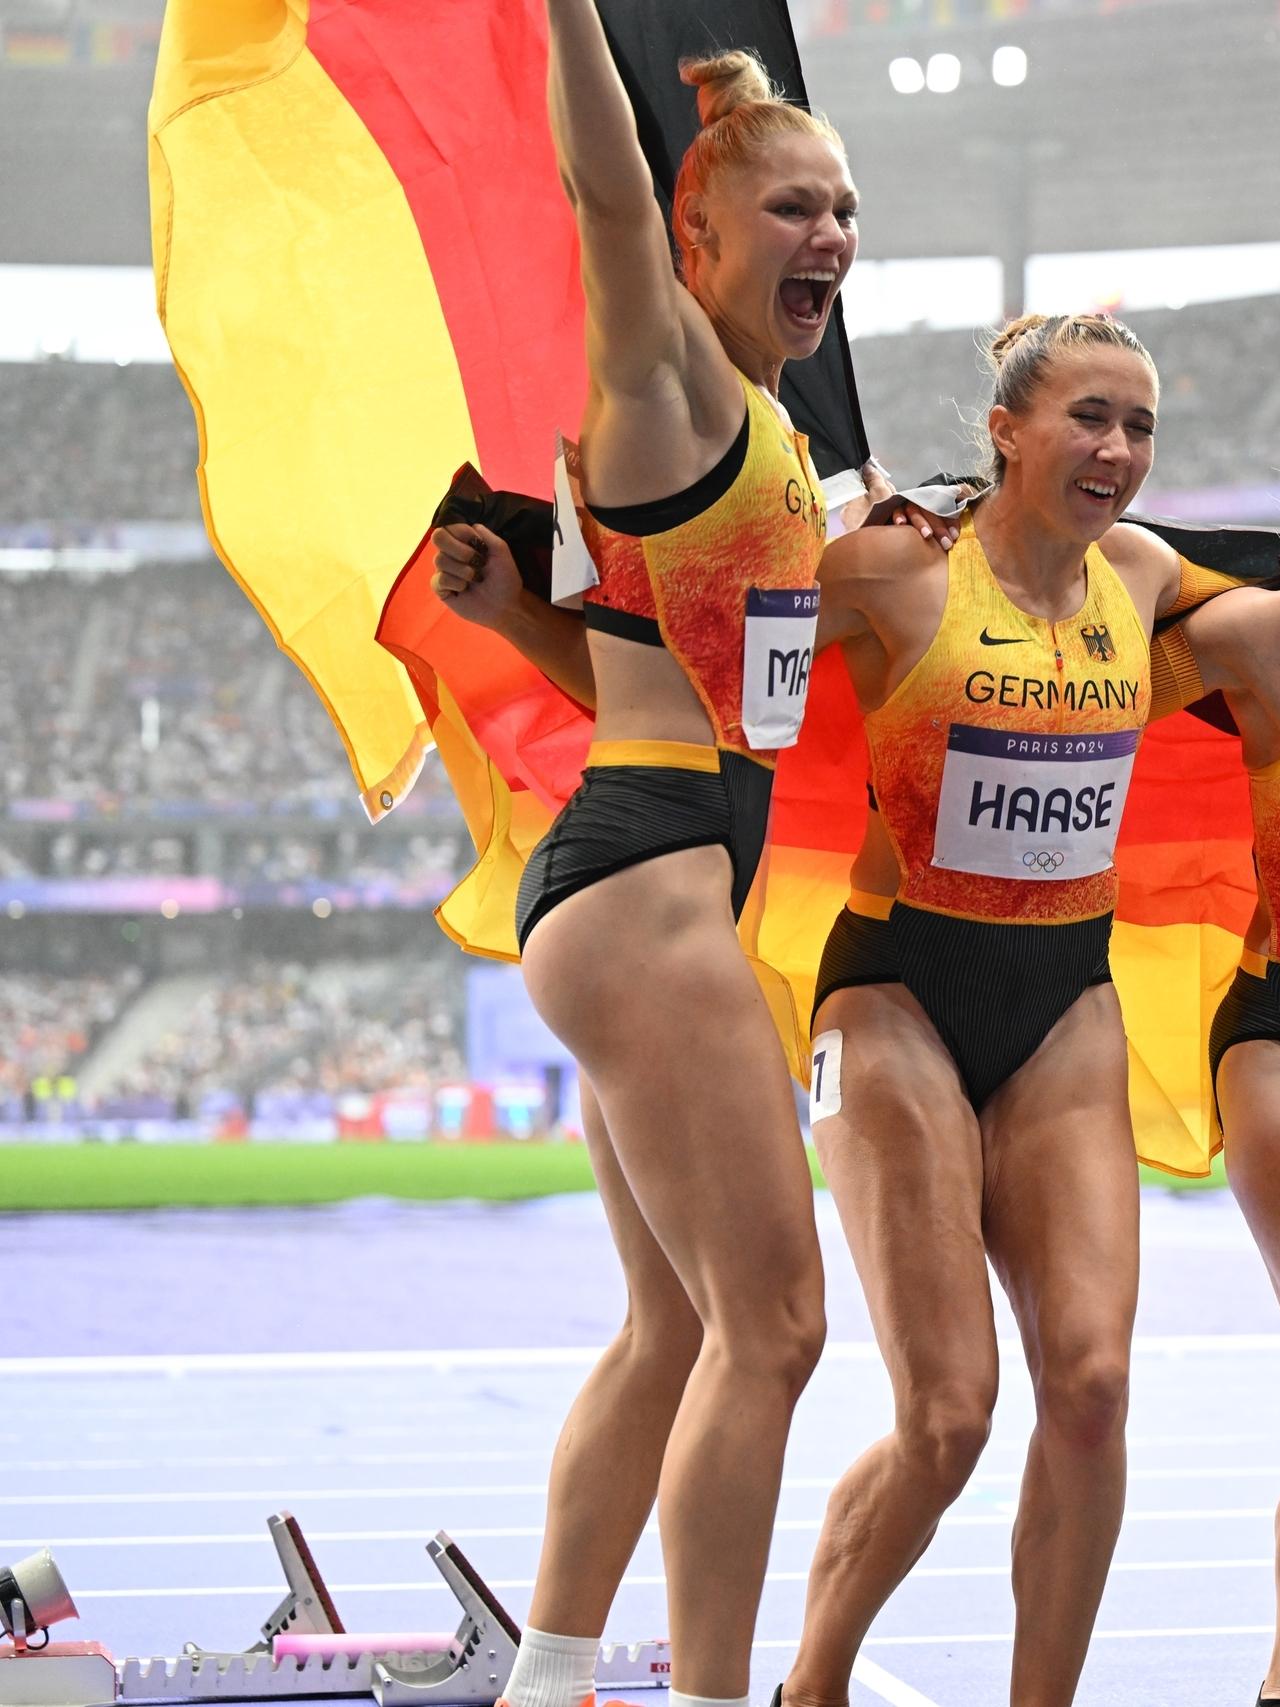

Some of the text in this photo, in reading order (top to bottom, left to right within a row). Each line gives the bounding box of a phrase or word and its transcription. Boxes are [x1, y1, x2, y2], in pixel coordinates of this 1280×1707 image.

[965, 671, 1139, 711] GERMANY
[1065, 739, 1104, 754] 2024
[968, 780, 1116, 833] HAASE
